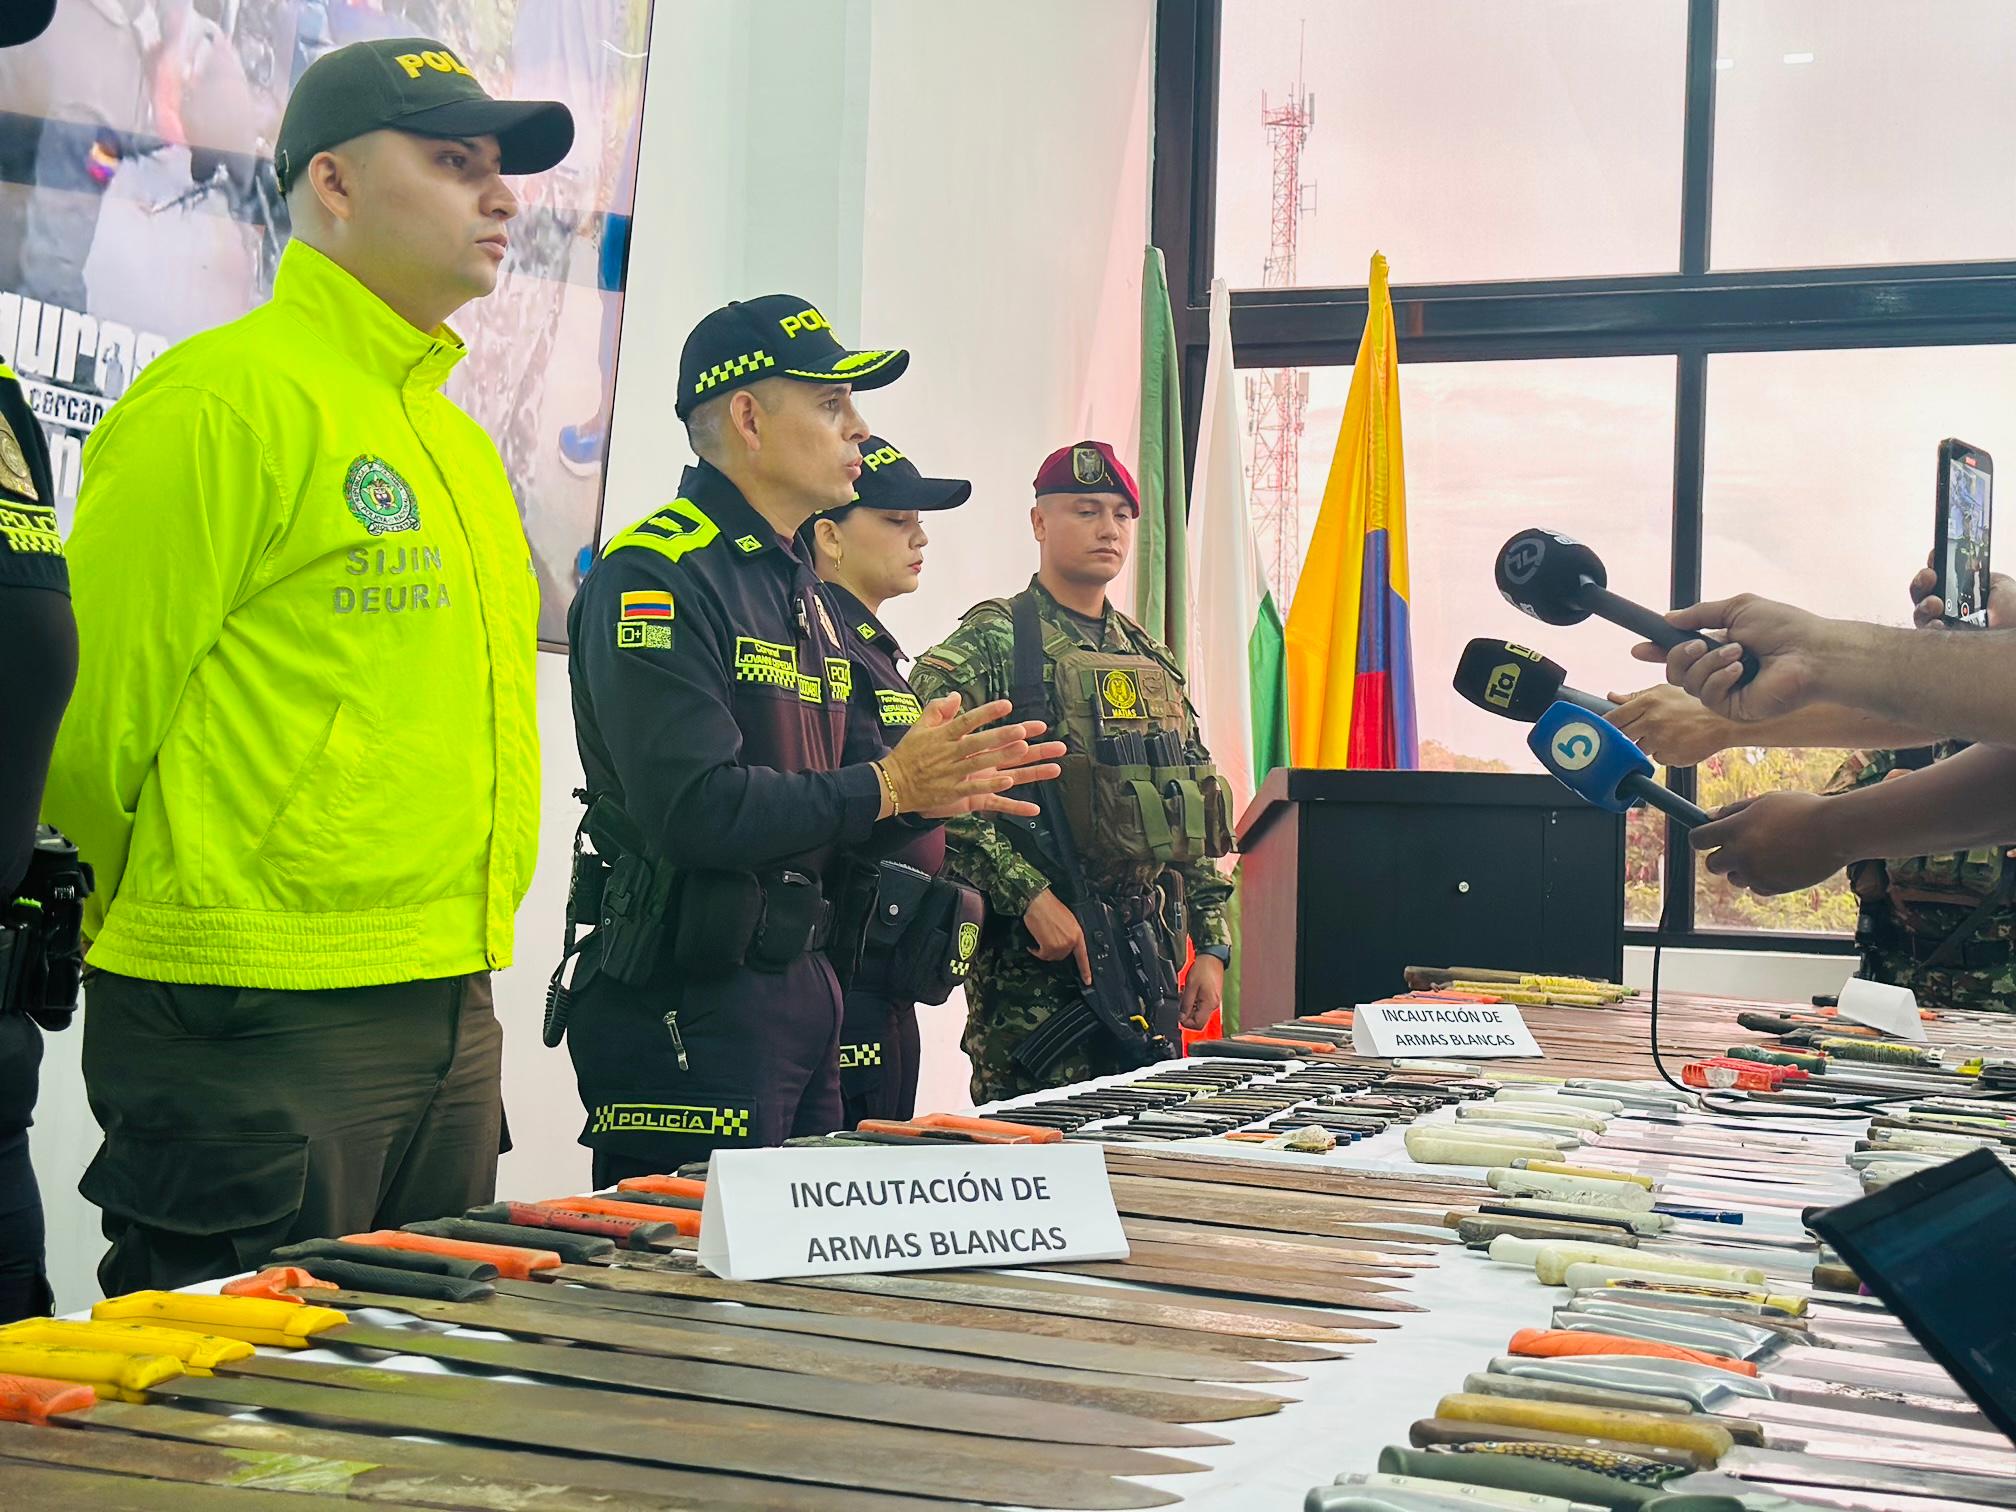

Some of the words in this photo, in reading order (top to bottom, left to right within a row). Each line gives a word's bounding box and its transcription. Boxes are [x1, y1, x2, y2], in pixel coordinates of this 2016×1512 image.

[345, 546, 442, 576] SIJIN
[334, 583, 452, 614] DEURA
[1381, 1007, 1480, 1023] INCAUTACIÓN
[1482, 1011, 1504, 1023] DE
[1395, 1034, 1449, 1047] ARMAS
[1451, 1034, 1516, 1047] BLANCAS
[618, 1111, 705, 1129] POLICÍA
[790, 1171, 1004, 1208] INCAUTACIÓN
[1011, 1176, 1051, 1202] DE
[807, 1232, 923, 1263] ARMAS
[929, 1226, 1068, 1257] BLANCAS
